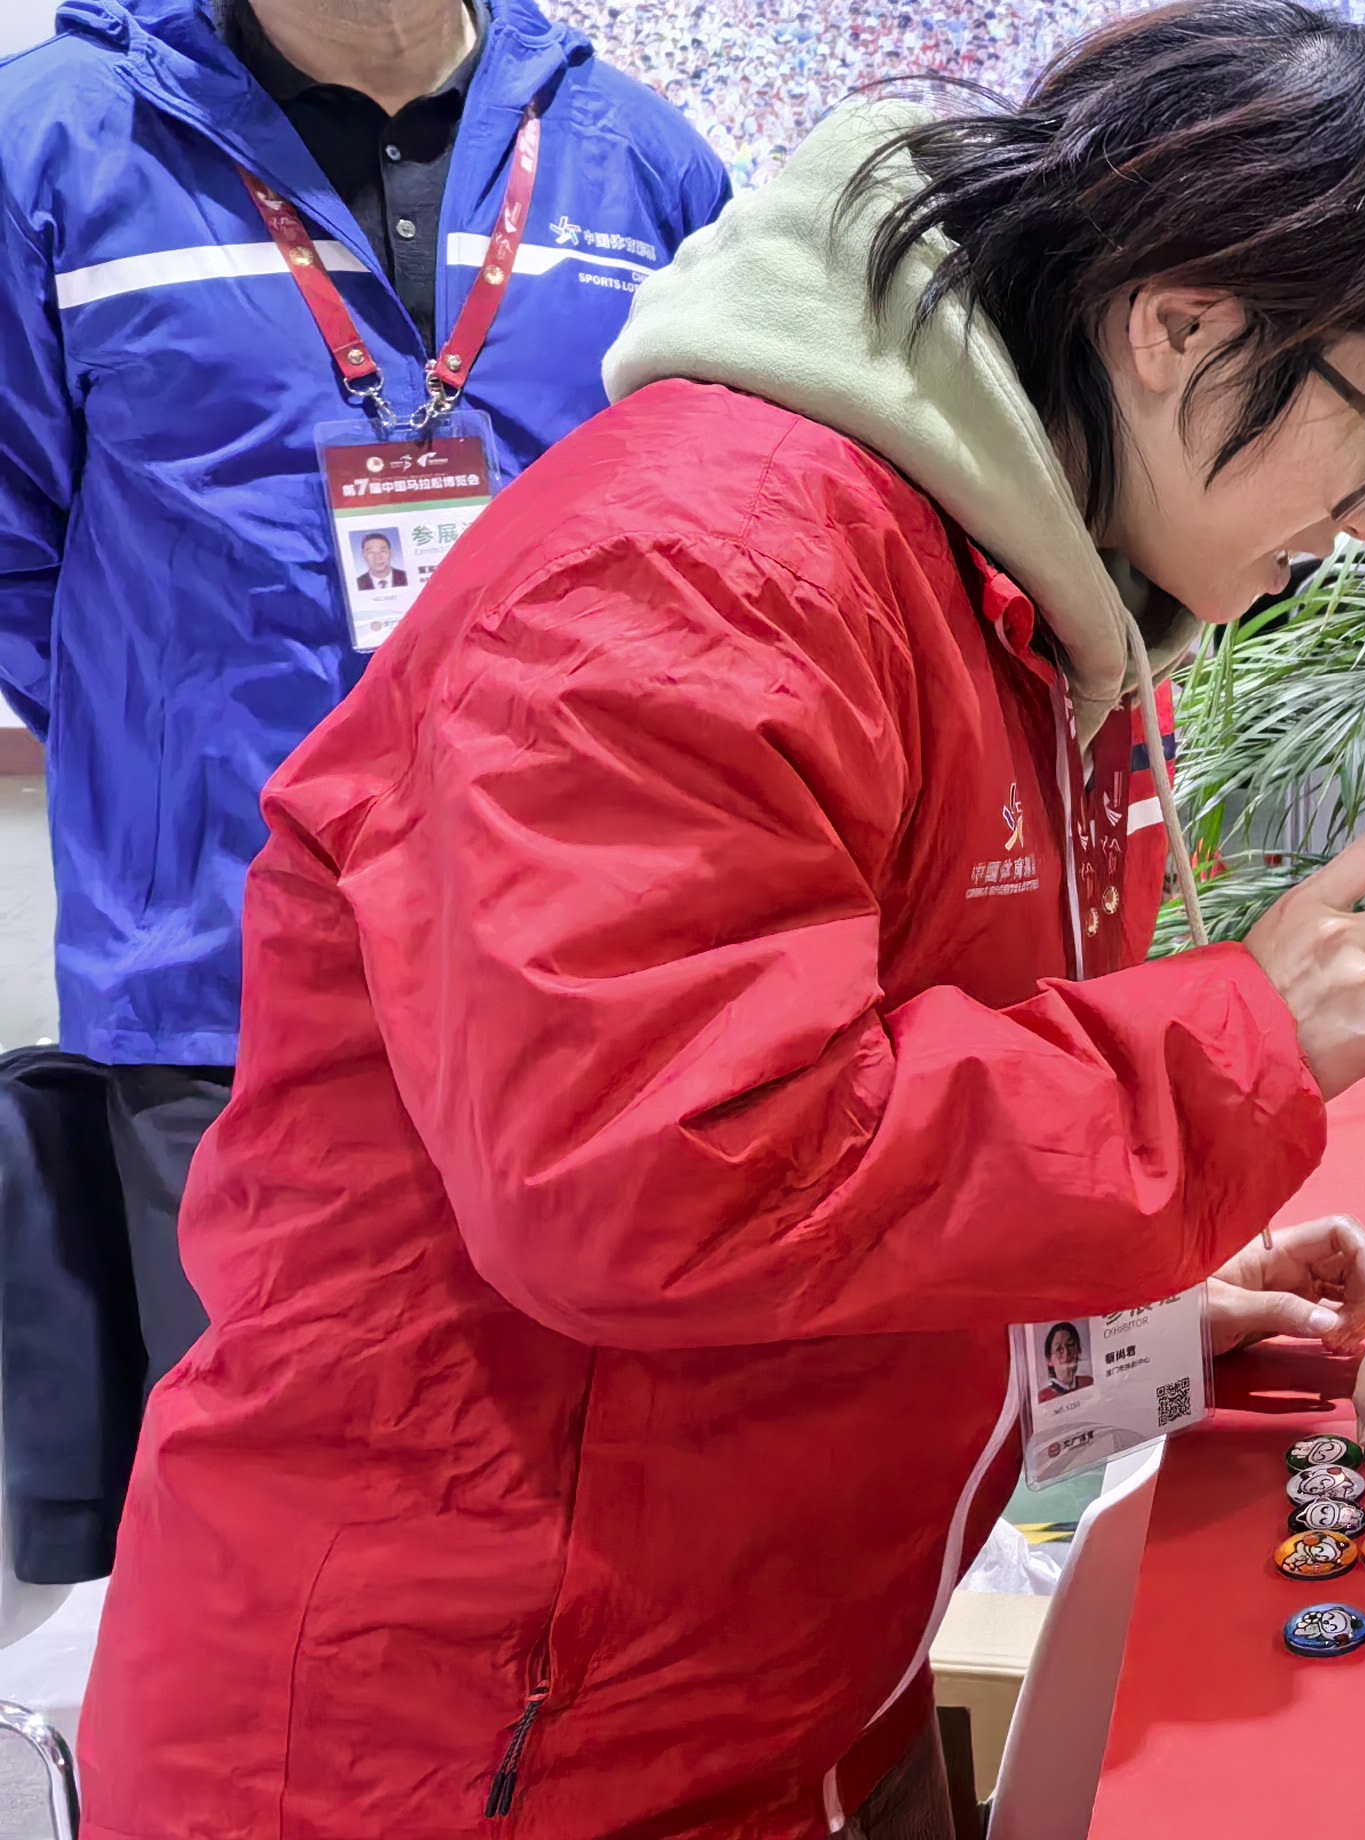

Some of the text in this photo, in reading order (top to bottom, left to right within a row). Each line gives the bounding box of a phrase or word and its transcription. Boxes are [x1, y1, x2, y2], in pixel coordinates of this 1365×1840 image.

[578, 272, 622, 290] SPORTS
[342, 473, 480, 498] 第7届中国马拉松博览会
[411, 522, 472, 547] 参展
